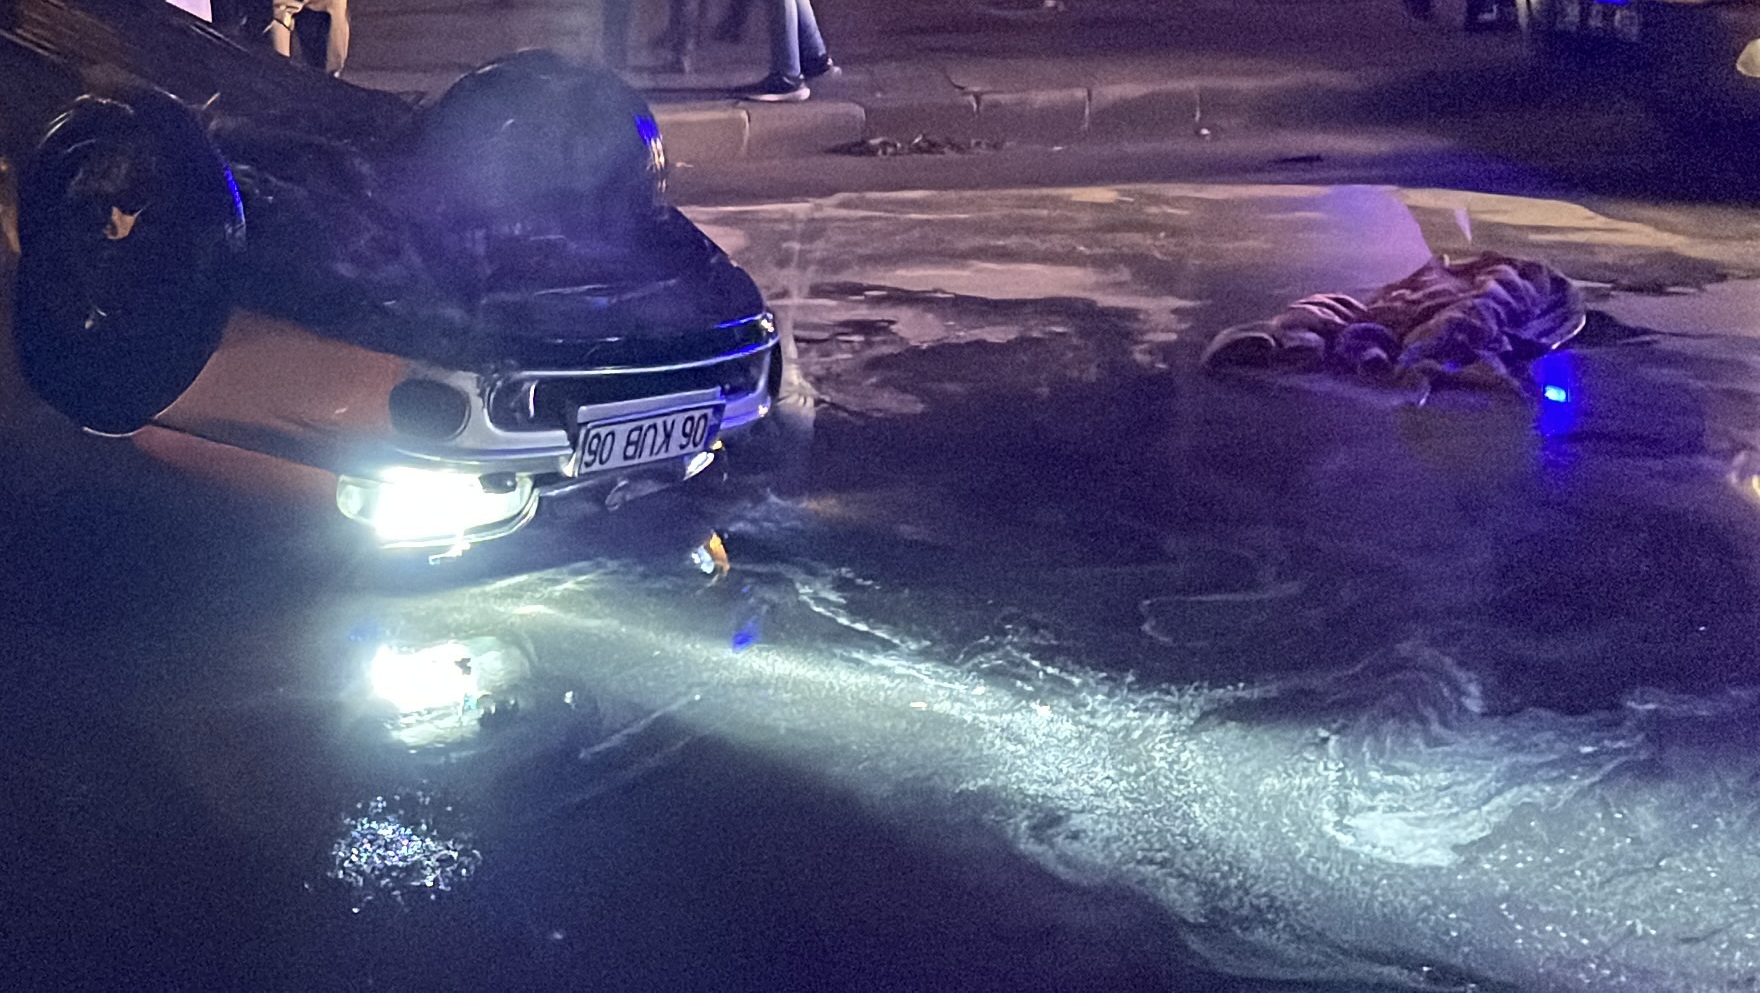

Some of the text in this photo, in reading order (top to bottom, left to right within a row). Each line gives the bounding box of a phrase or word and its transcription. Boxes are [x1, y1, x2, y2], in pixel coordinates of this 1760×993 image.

[585, 412, 709, 468] 06 KUB 06
